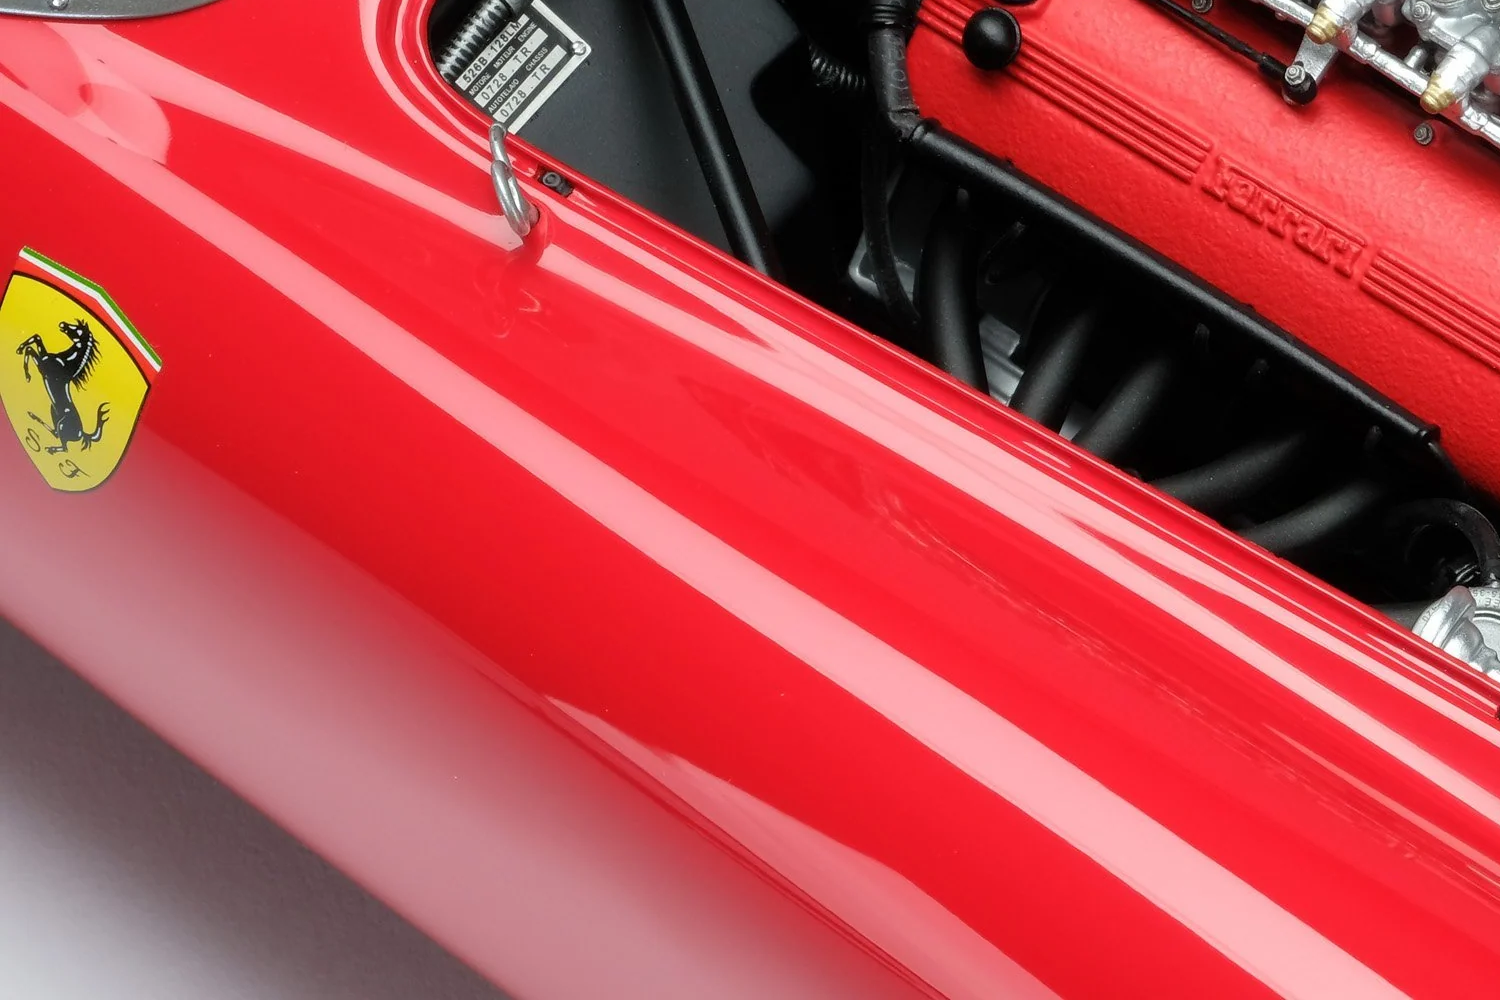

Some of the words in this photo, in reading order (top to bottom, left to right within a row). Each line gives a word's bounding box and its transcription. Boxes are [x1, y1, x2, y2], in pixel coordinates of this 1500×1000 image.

[469, 72, 492, 96] MOTORE
[493, 45, 516, 69] MOTEUR
[518, 21, 538, 43] ENGINE
[488, 78, 520, 113] AUTOTELAIO
[525, 46, 549, 72] CHASSIS
[1201, 155, 1367, 278] Ferrari
